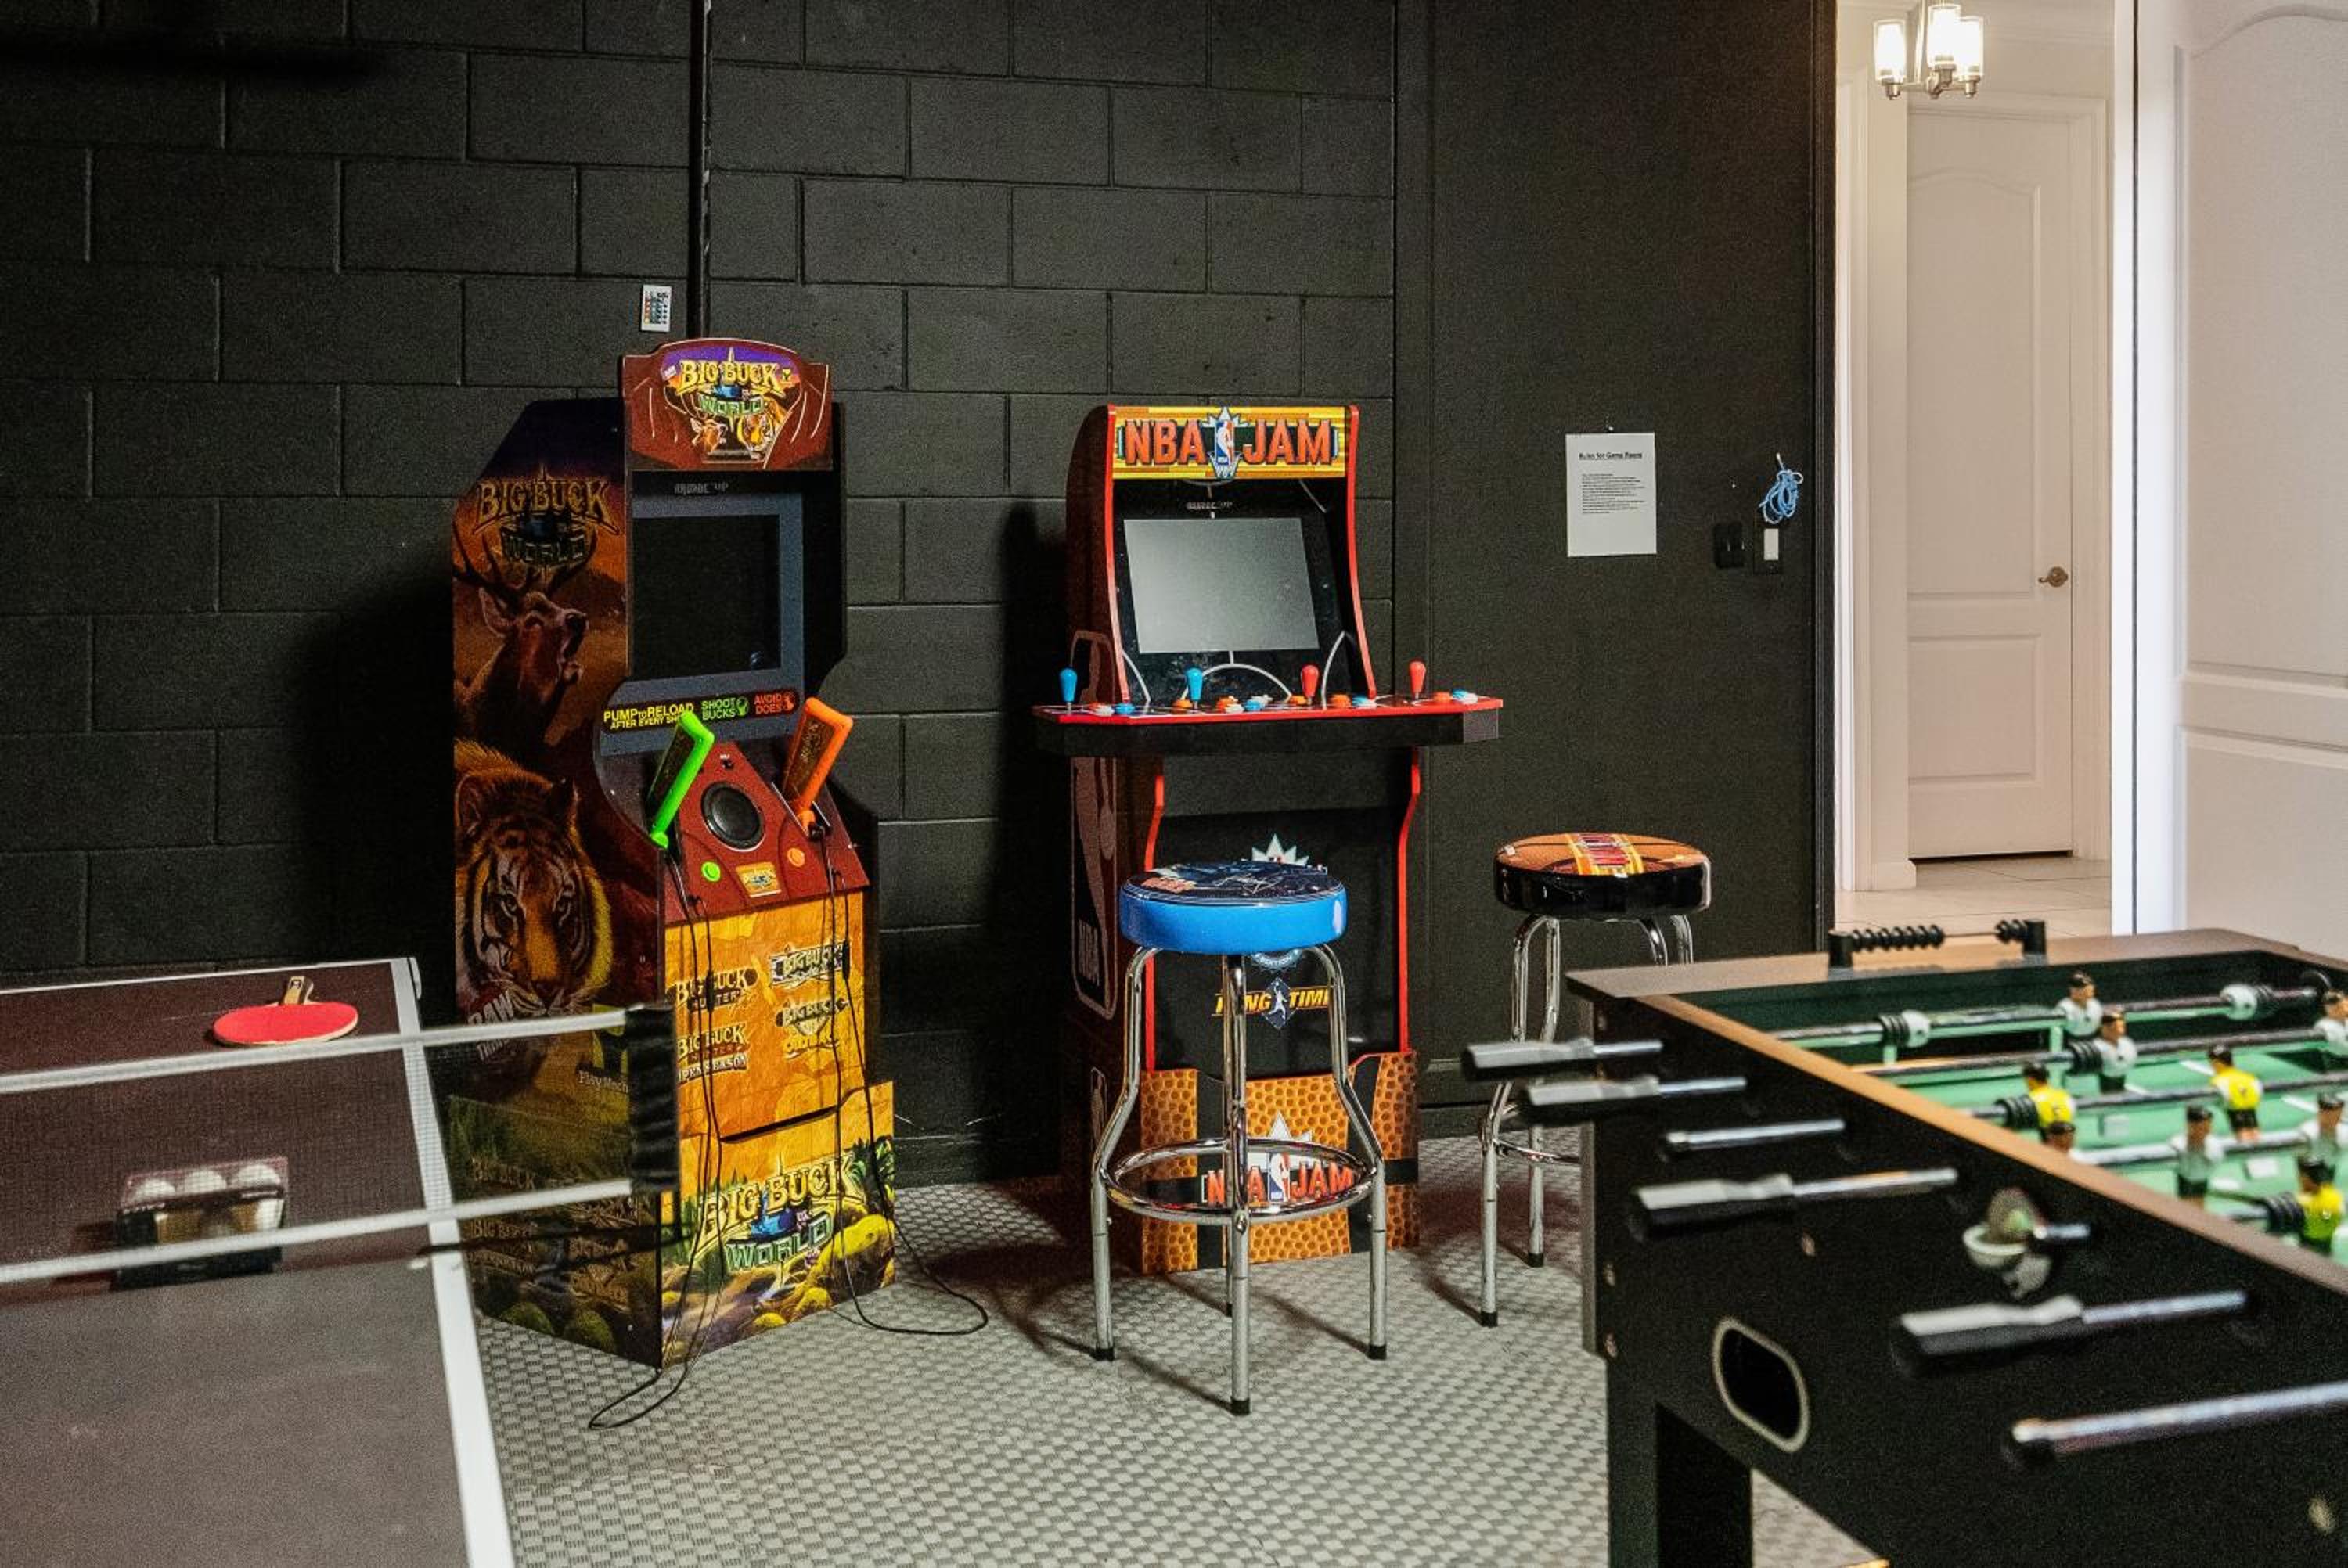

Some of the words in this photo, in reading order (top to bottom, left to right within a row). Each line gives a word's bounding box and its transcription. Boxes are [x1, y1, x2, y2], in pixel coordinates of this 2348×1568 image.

[677, 360, 718, 394] BIG
[723, 361, 785, 397] BUCK
[699, 394, 765, 415] WORLD
[1124, 419, 1208, 466] NBA
[1243, 419, 1334, 465] JAM
[474, 481, 526, 534] BIG
[531, 481, 619, 535] BUCK
[700, 698, 736, 710] SHOOT
[754, 693, 782, 705] AVOID
[755, 703, 782, 714] DOES
[603, 708, 637, 722] PUMP
[647, 703, 694, 717] RELOAD
[610, 719, 637, 729] AFTER
[638, 717, 664, 727] EVERY
[702, 707, 736, 721] BUCKS
[711, 968, 748, 990] UCK
[692, 989, 739, 1010] UTER
[1289, 987, 1331, 1008] TIM
[677, 1035, 700, 1060] BIG
[1206, 1166, 1268, 1205] NA
[1290, 1161, 1354, 1201] JAM
[690, 1184, 761, 1261] BIG
[766, 1153, 866, 1213] BUCK
[726, 1214, 834, 1271] WORLD
